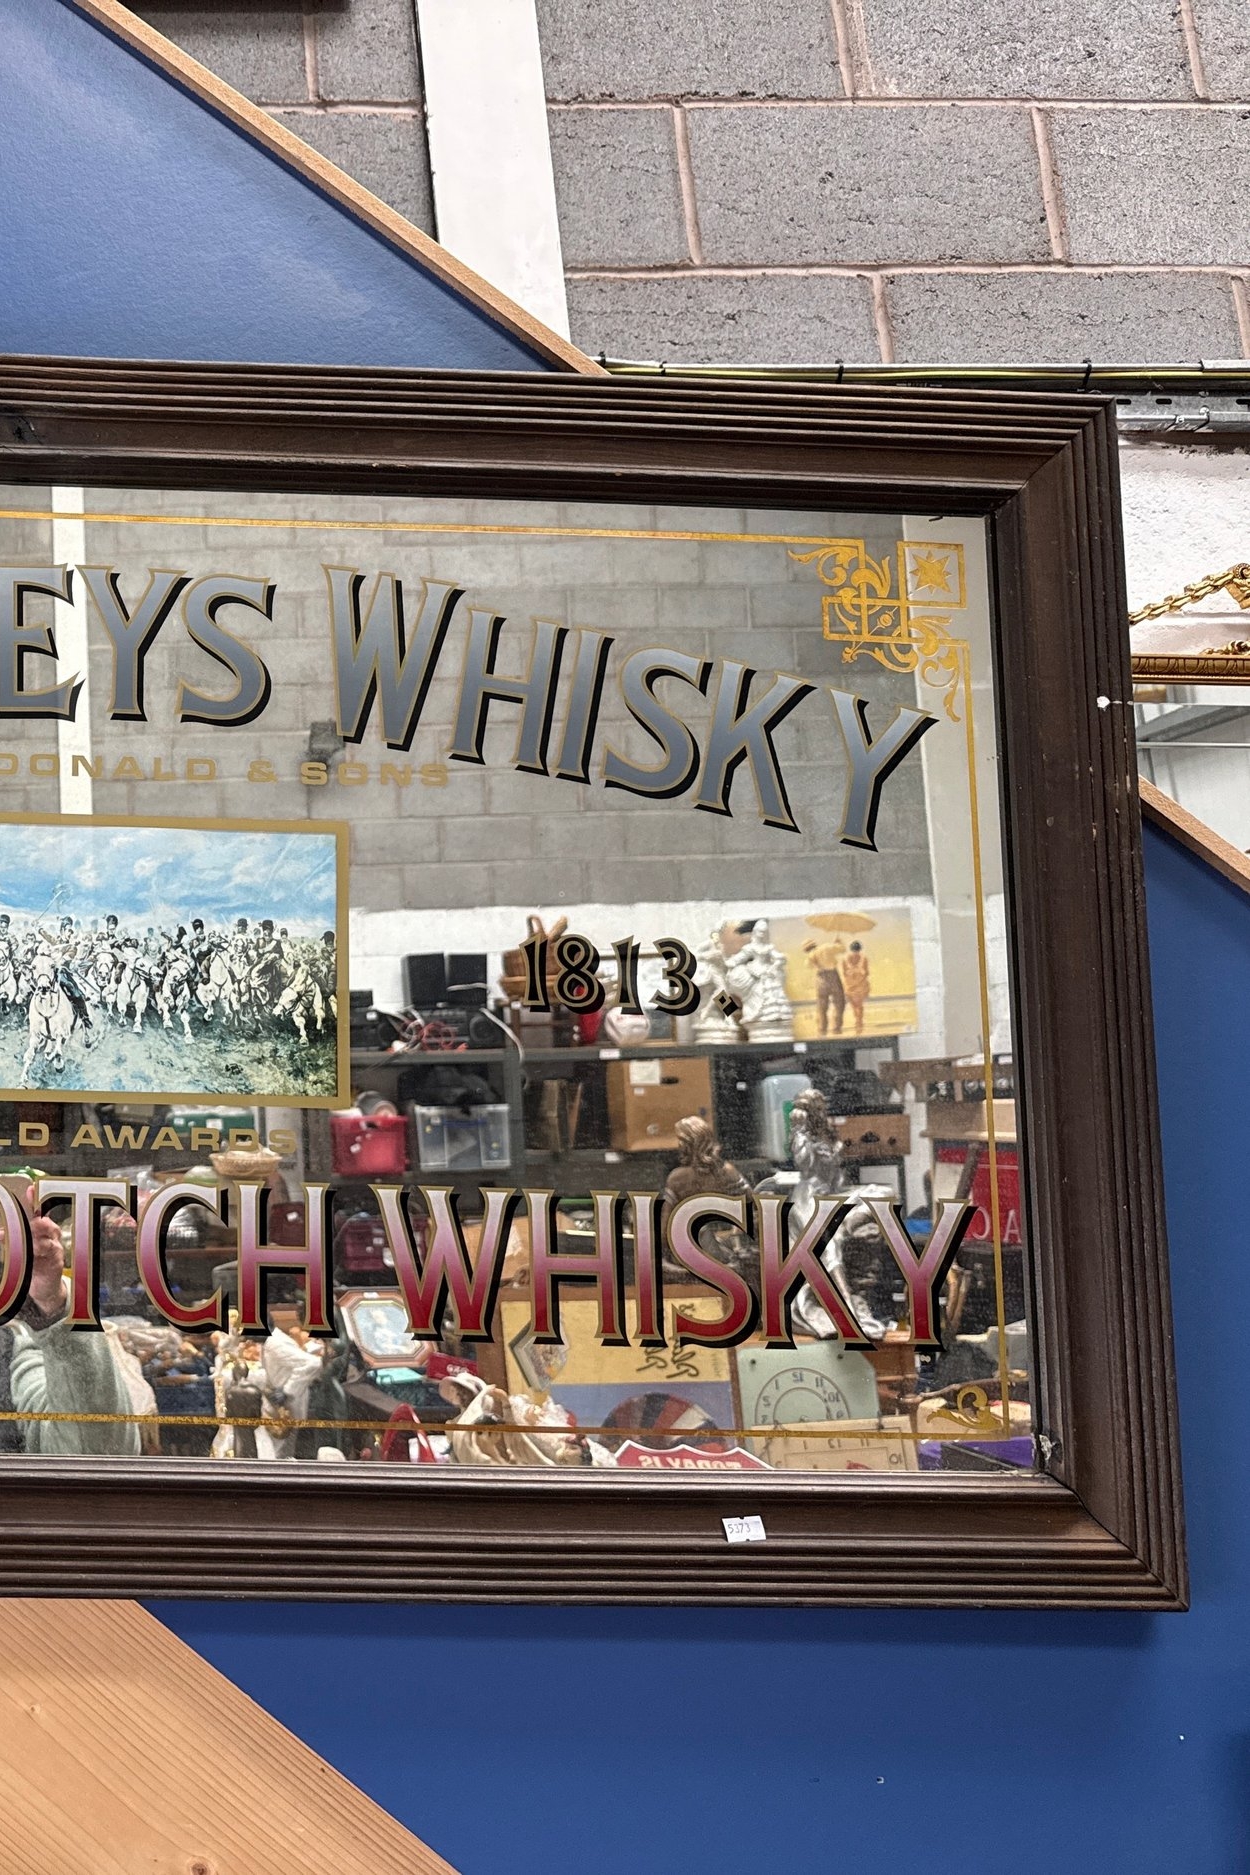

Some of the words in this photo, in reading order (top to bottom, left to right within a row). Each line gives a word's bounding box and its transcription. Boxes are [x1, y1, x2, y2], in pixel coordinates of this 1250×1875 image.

[321, 564, 939, 852] WHISKY
[247, 760, 278, 783] &
[301, 761, 449, 787] SONS
[70, 1124, 298, 1154] AWARDS
[369, 1184, 980, 1351] WHISKY
